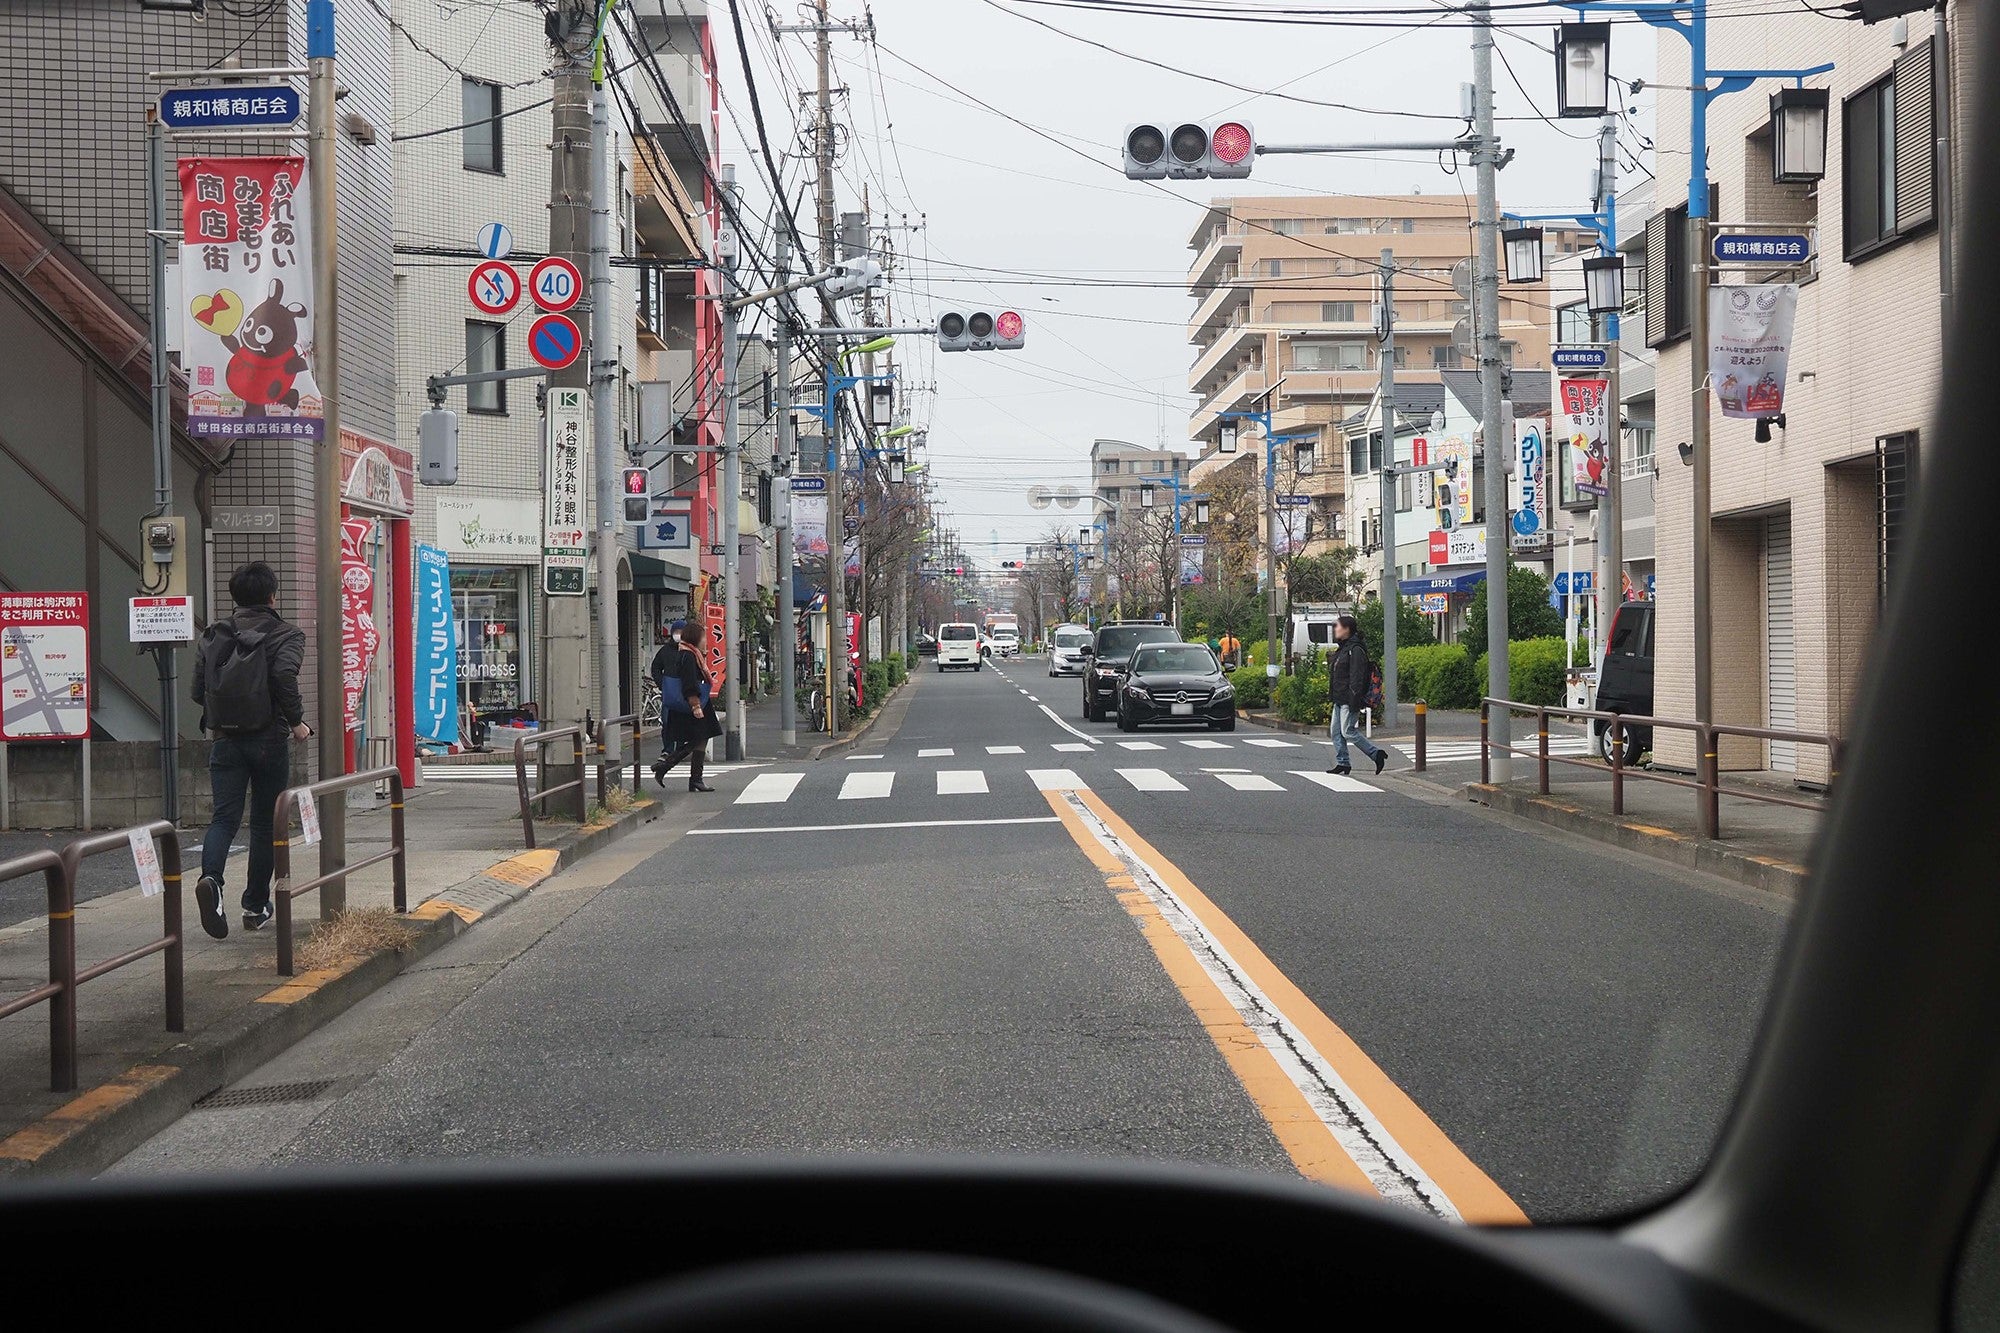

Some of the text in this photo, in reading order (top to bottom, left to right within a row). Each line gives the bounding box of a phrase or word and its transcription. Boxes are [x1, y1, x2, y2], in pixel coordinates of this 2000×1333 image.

[173, 97, 288, 118] 親和橋商店会
[196, 175, 230, 273] 商店街
[235, 177, 264, 274] みまもり
[270, 173, 296, 268] ふれあい
[1723, 242, 1801, 255] 親和橋商店会
[541, 273, 570, 297] 40
[1557, 354, 1601, 362] 親和橋商店会
[1568, 386, 1582, 425] 商店街
[1582, 387, 1595, 426] みまもり
[197, 421, 315, 436] 世田谷区商店街連合会
[564, 420, 578, 526] 神谷整形外科・眼科
[1522, 437, 1535, 512] クリーニン
[555, 582, 578, 590] 2-40
[1, 609, 81, 620] をご利用下さい。
[429, 567, 449, 738] コインランドリー
